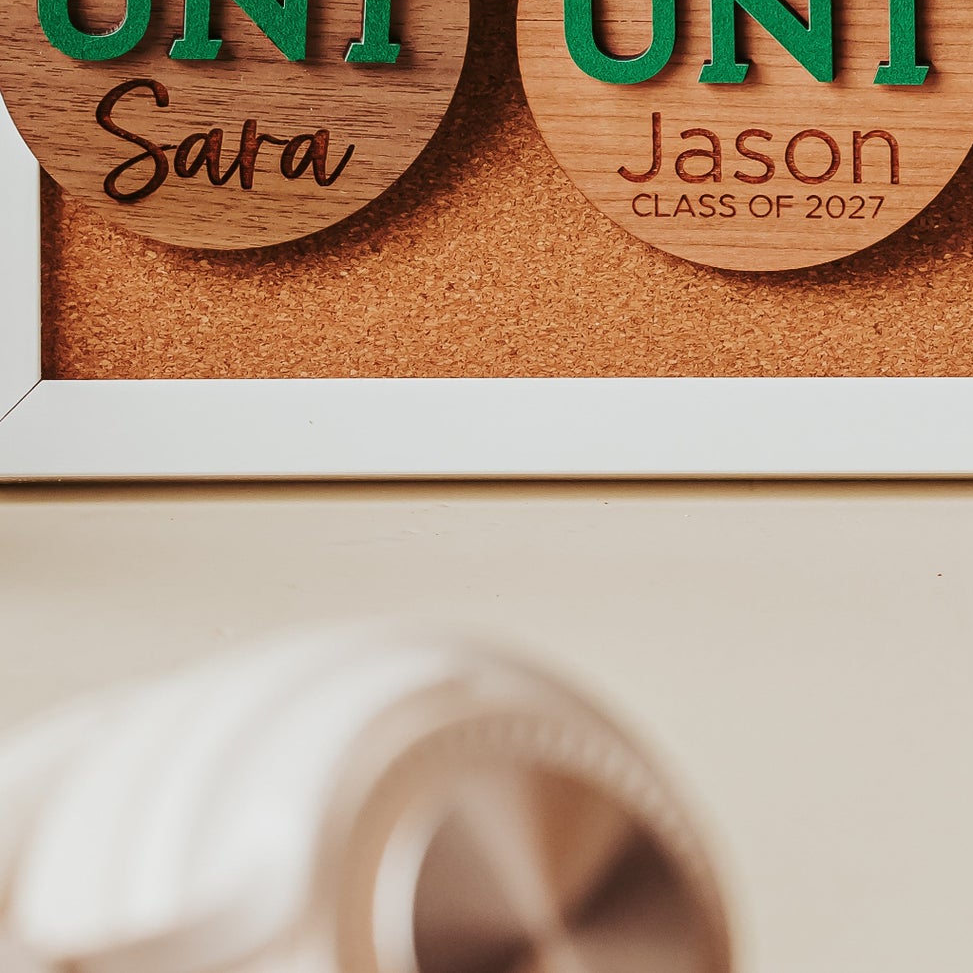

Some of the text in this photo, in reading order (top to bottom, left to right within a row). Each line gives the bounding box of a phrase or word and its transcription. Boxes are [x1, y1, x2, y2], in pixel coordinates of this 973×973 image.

[95, 78, 355, 203] Sara
[617, 112, 900, 185] Jason
[631, 193, 886, 219] CLASS OF 2027
